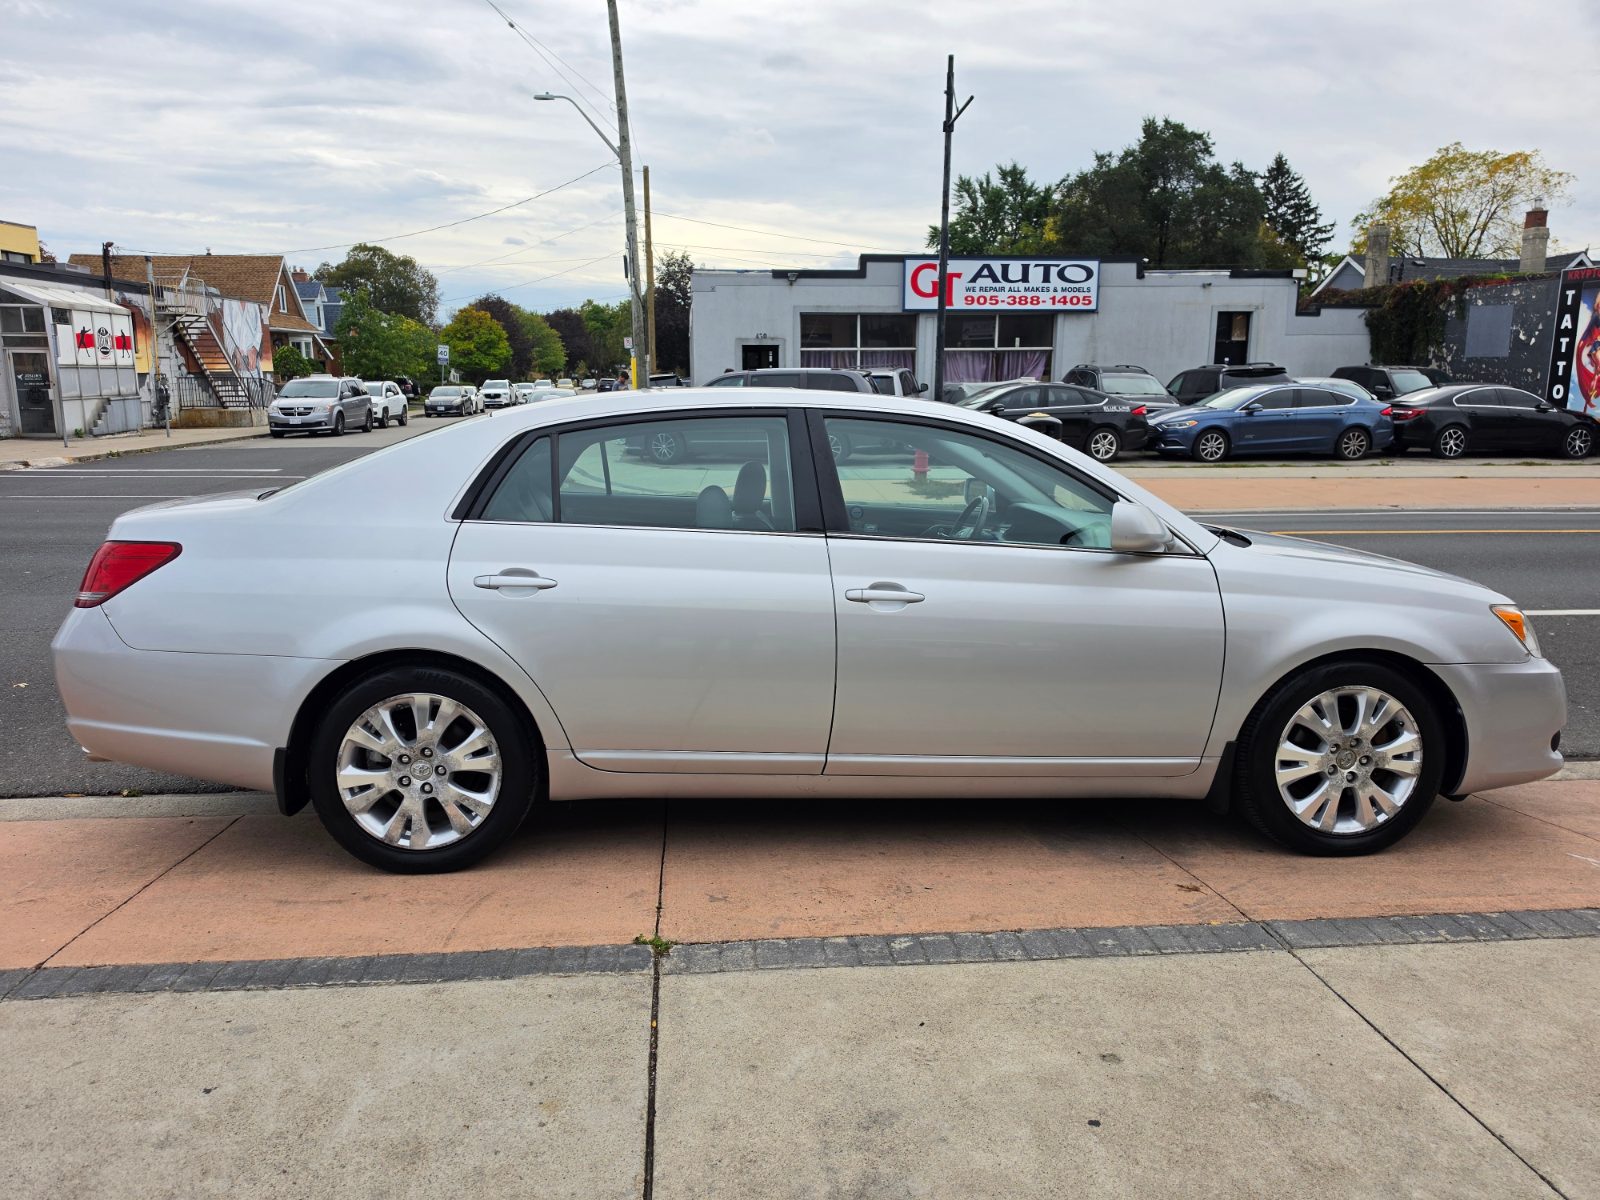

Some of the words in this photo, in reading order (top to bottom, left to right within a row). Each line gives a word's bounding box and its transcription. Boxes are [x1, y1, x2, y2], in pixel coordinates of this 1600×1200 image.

[910, 263, 962, 306] GT
[967, 264, 1094, 283] AUTO
[964, 295, 1092, 306] 905-388-1405
[1552, 289, 1576, 399] TATTO
